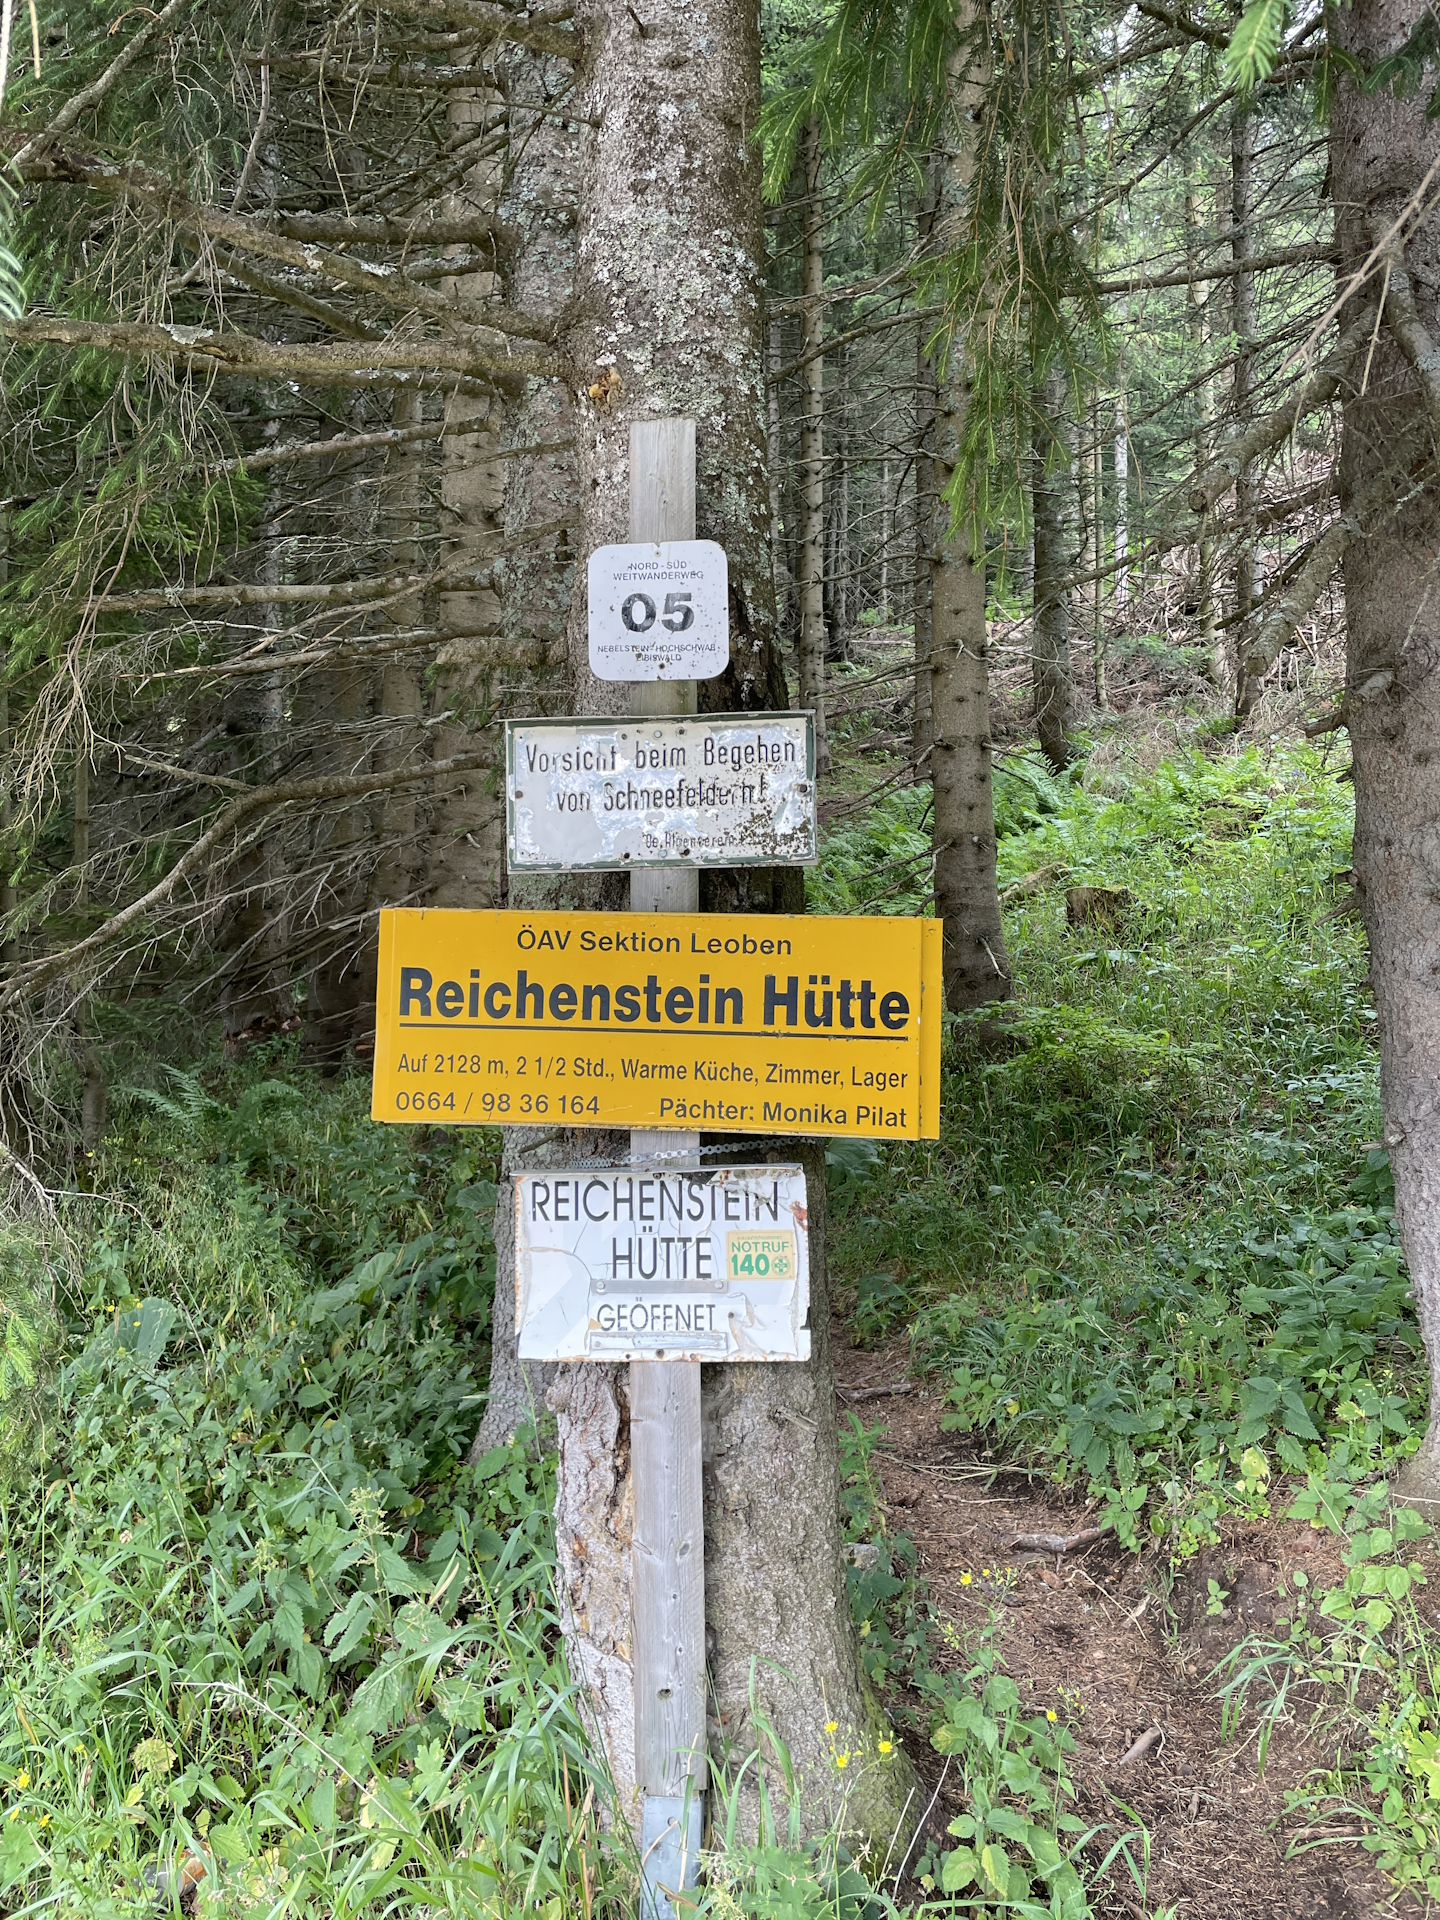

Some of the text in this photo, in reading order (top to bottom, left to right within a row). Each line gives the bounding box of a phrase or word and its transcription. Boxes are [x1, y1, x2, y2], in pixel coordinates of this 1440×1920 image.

[613, 570, 704, 581] WEITWANDERWEG
[630, 562, 659, 571] NORD
[666, 559, 687, 570] SÜD
[621, 592, 695, 633] 05
[526, 734, 795, 773] Vorsicht beim Begehen
[557, 791, 591, 812] von
[517, 924, 792, 956] ÖAV Sektion Leoben
[399, 967, 910, 1030] Reichenstein Hütte
[397, 1053, 909, 1091] Auf 2128 m, 2 1/2 Std., Warme Küche, Zimmer, Lager
[396, 1091, 601, 1116] 0664 / 98 36 164
[659, 1097, 908, 1129] Pächter: Monika Pilat
[531, 1179, 778, 1222] REICHENSTEIN
[612, 1226, 712, 1279] HÜTTE
[731, 1240, 790, 1253] NOTRUF
[731, 1253, 770, 1276] 140
[597, 1296, 716, 1332] GEÖFFNET
